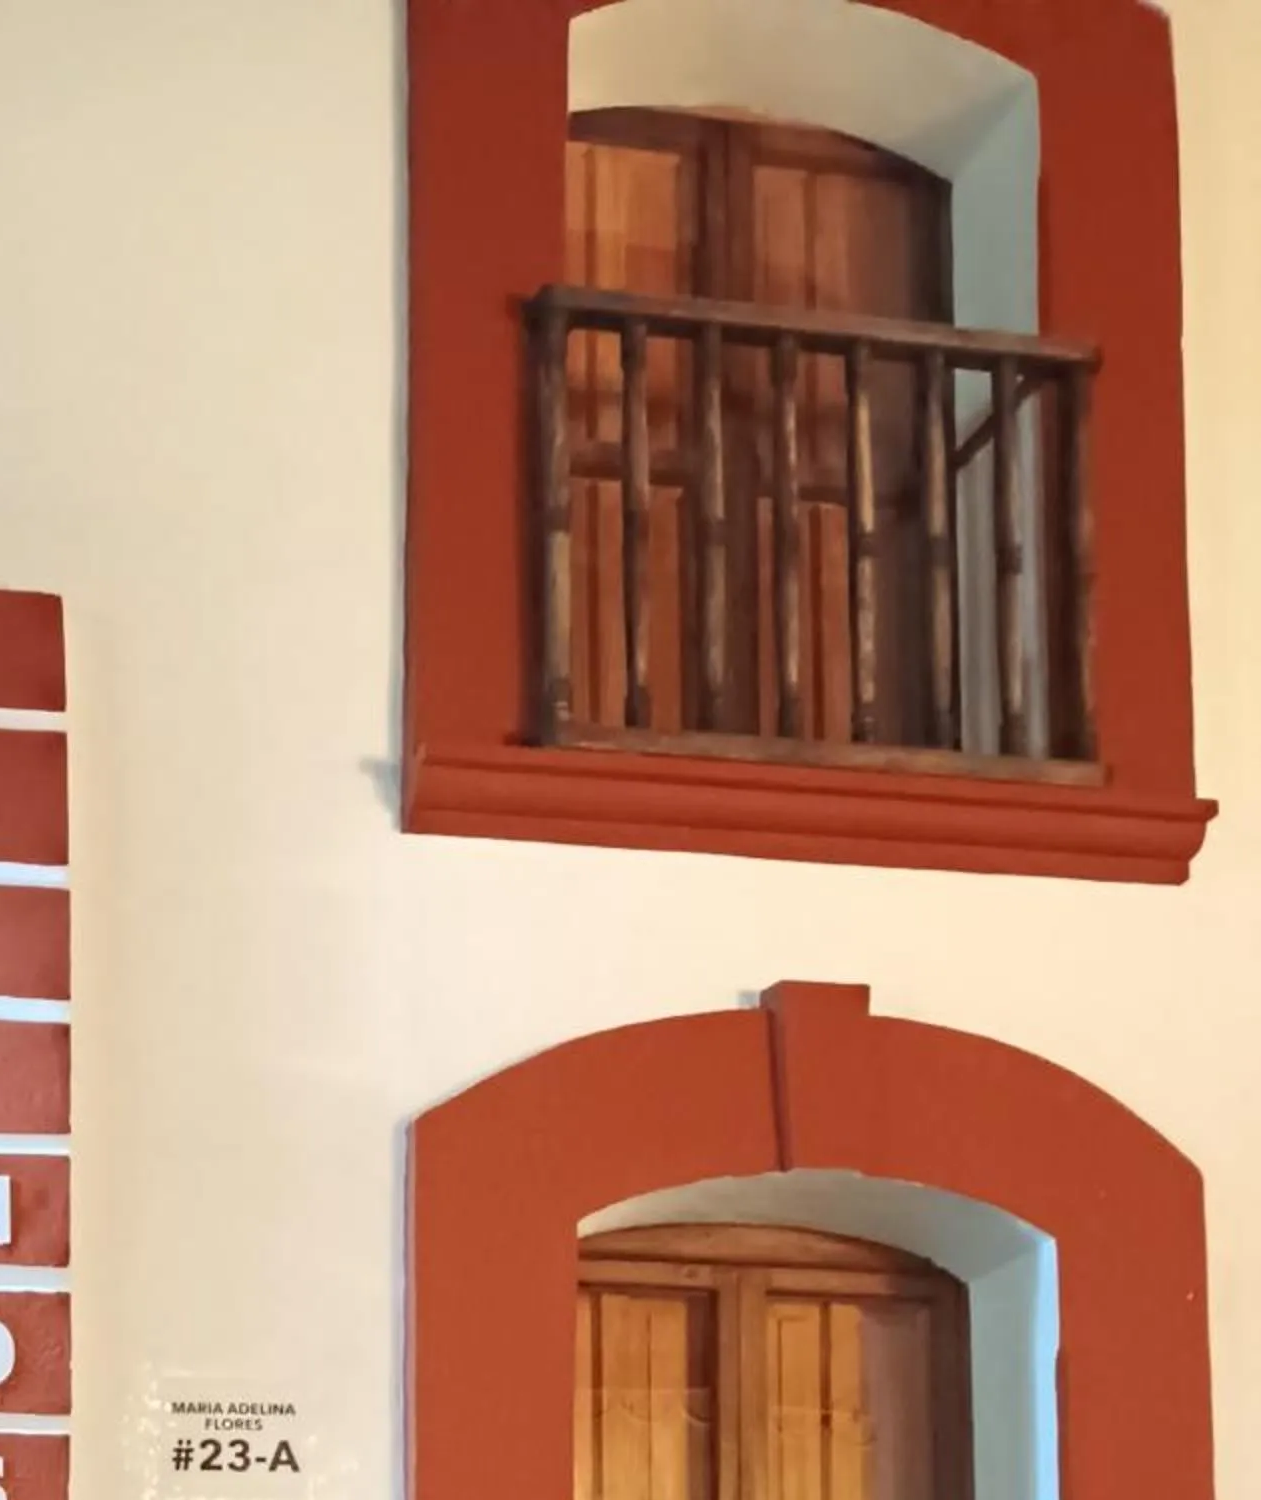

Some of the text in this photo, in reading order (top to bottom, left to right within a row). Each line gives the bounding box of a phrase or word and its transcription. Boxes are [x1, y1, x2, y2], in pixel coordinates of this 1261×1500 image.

[171, 1402, 297, 1416] MARIA ADELINA
[204, 1418, 263, 1431] FLORES
[172, 1438, 301, 1473] #23-A
